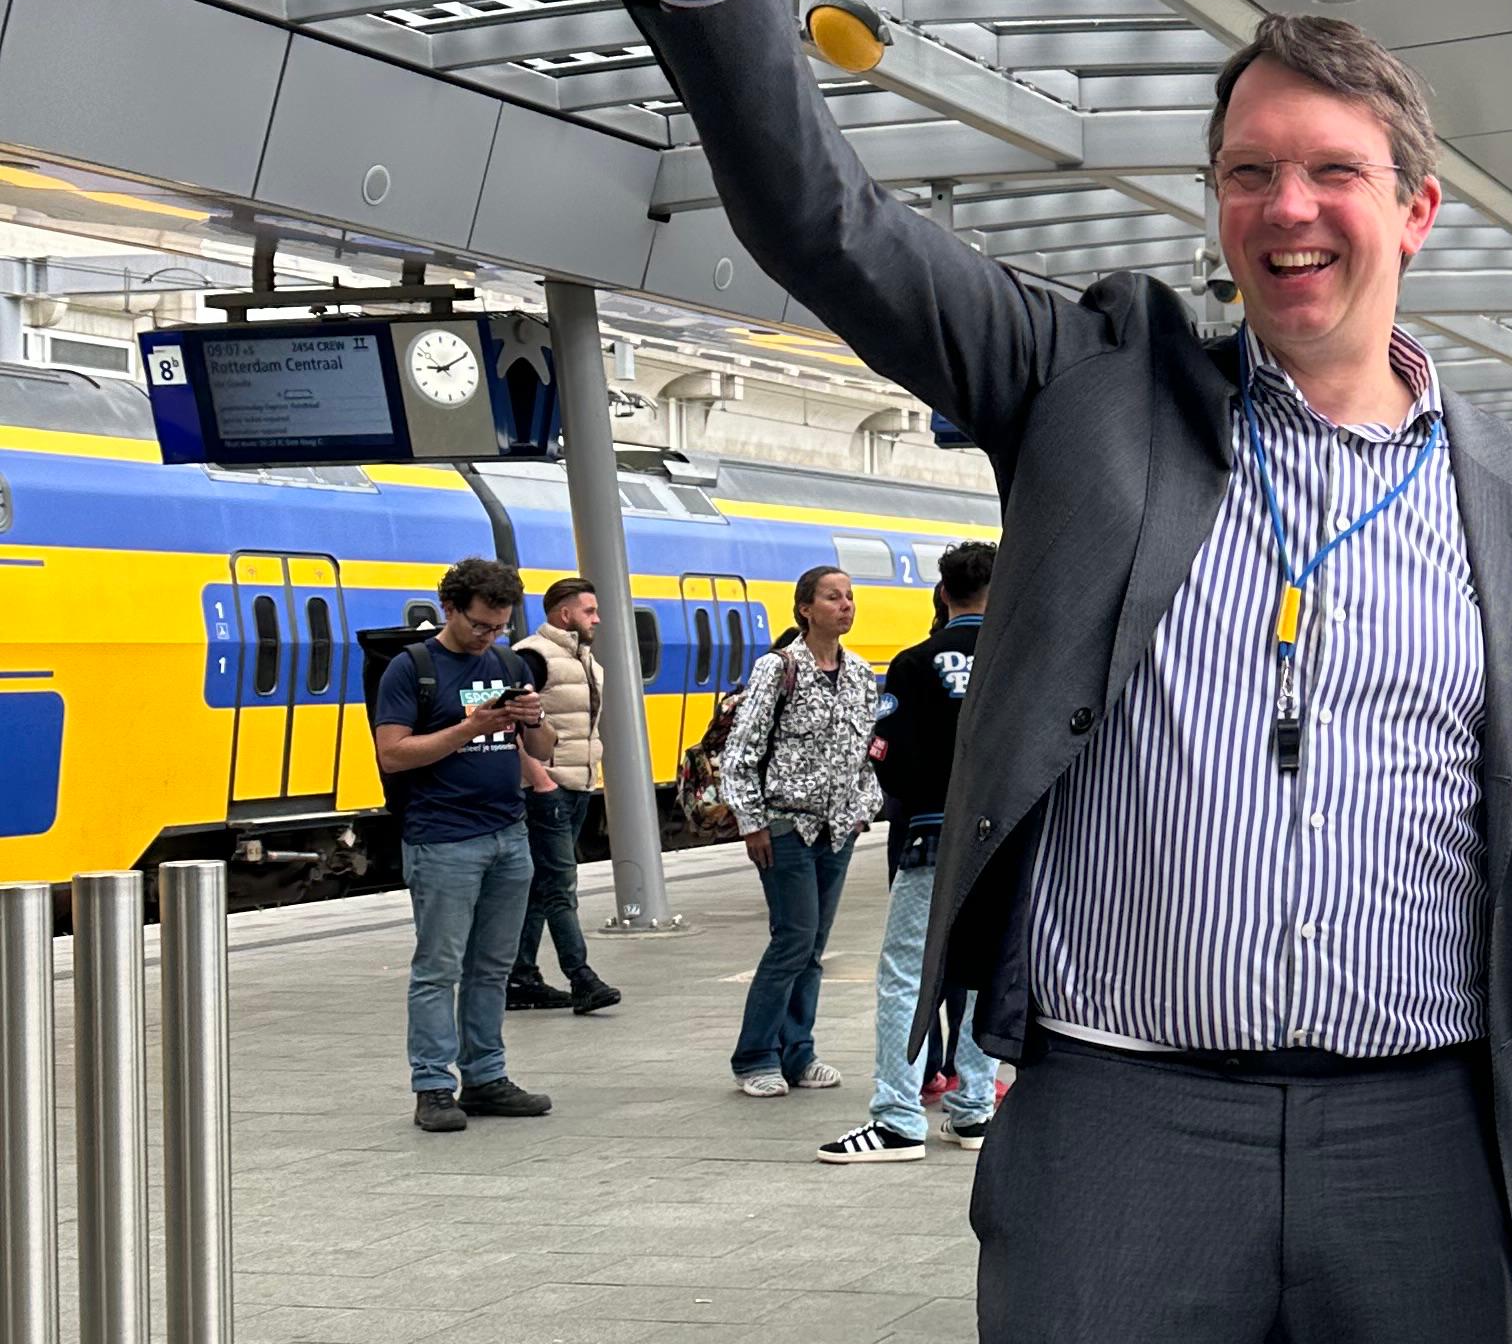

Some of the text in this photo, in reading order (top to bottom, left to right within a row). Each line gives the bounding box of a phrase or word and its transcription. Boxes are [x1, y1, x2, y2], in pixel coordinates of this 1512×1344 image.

[207, 343, 240, 357] 09:07
[210, 355, 344, 375] Rotterdam Centraal
[900, 556, 914, 584] 2
[215, 601, 225, 619] 1
[756, 614, 765, 628] 2
[218, 656, 227, 674] 1
[464, 690, 505, 704] SPOO
